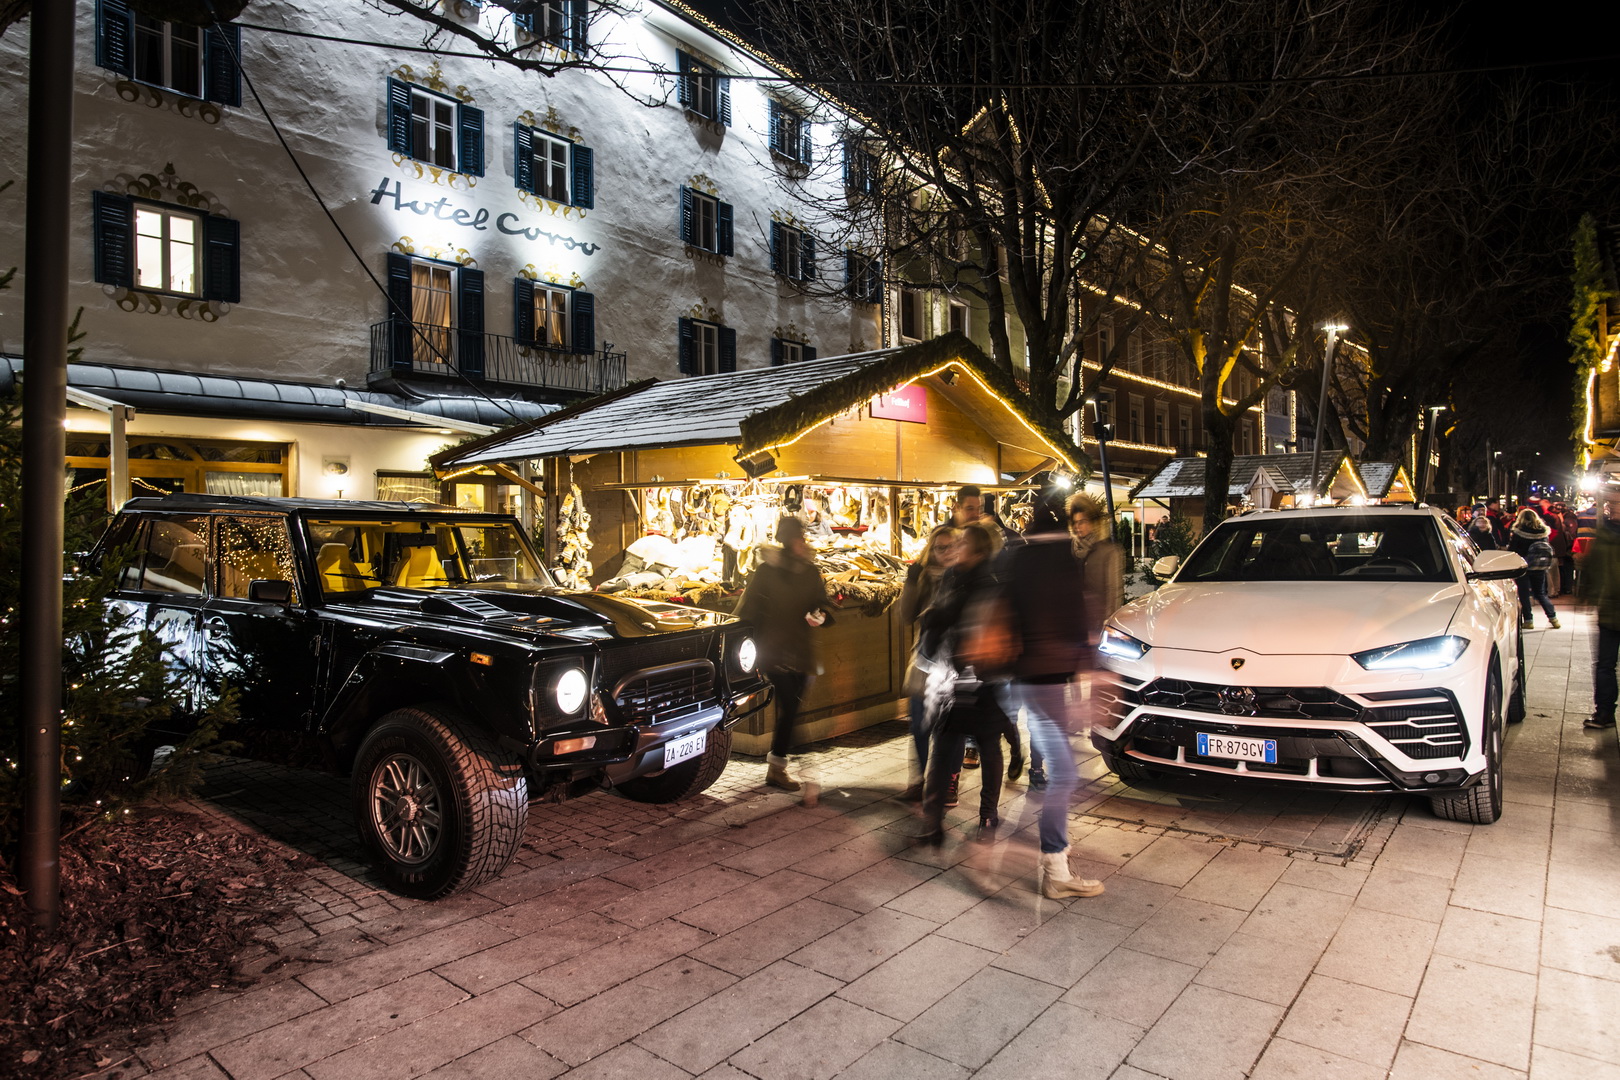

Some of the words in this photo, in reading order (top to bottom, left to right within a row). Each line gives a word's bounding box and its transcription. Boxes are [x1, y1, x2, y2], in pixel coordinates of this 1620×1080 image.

[370, 177, 489, 230] Hotel
[496, 212, 601, 256] Corso
[665, 747, 676, 762] ZA
[696, 735, 705, 751] EY
